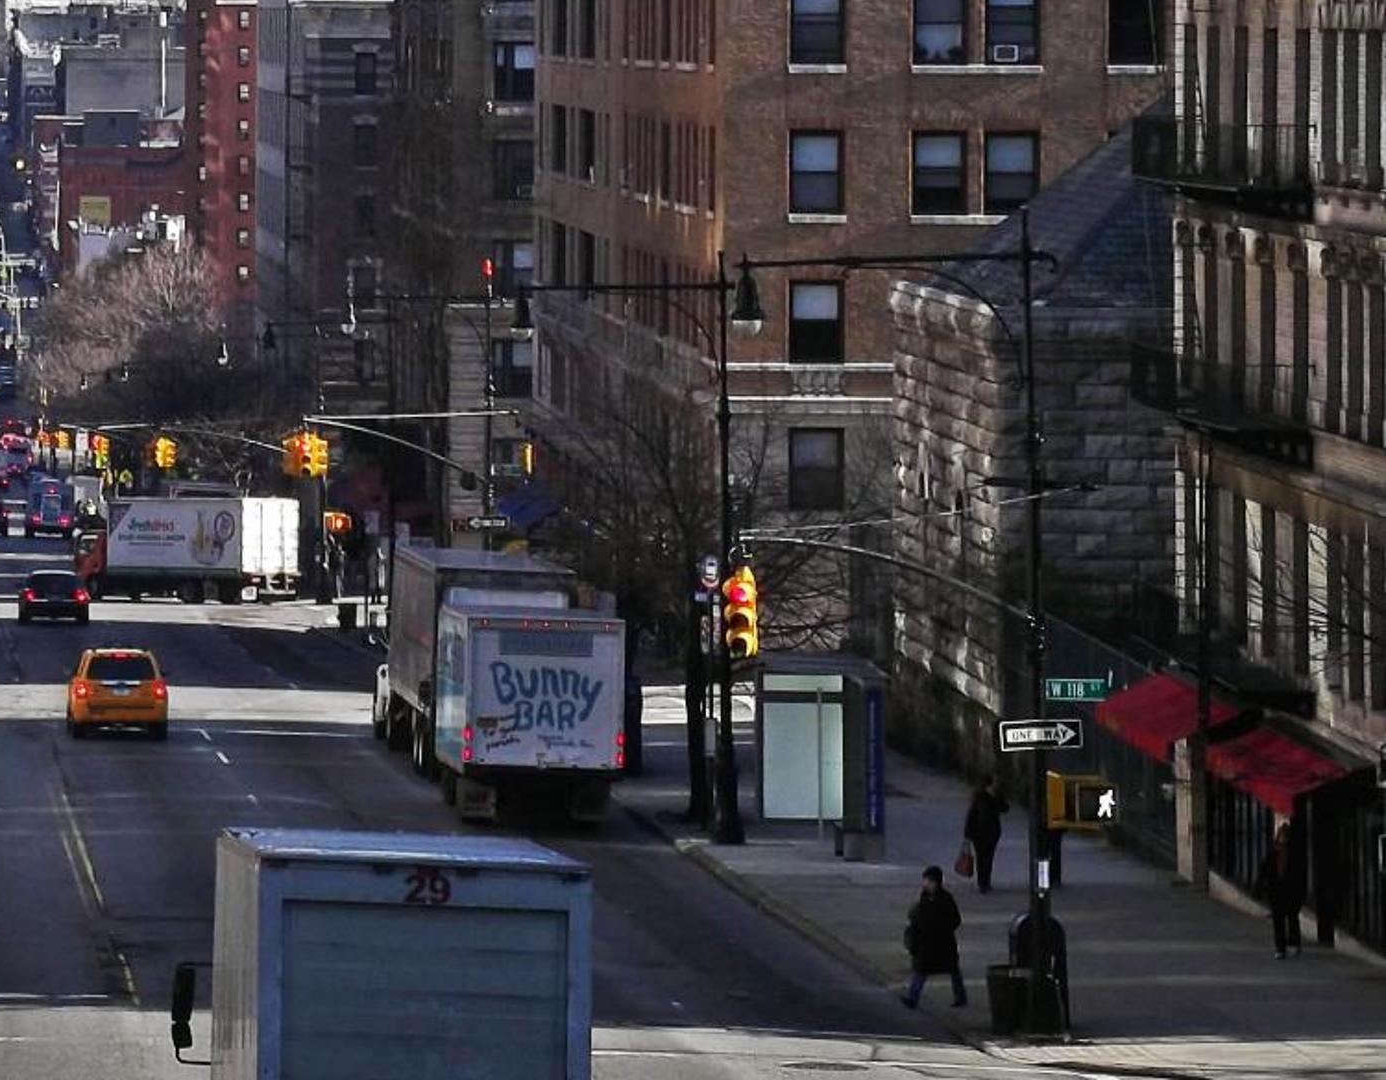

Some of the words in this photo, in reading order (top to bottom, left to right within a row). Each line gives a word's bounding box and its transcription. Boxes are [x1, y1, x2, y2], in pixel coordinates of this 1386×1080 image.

[490, 661, 604, 722] Bunny
[1051, 682, 1062, 697] W
[513, 700, 577, 731] BAR
[1010, 730, 1033, 742] ONE
[1043, 728, 1069, 741] WAY
[404, 874, 451, 905] 29
